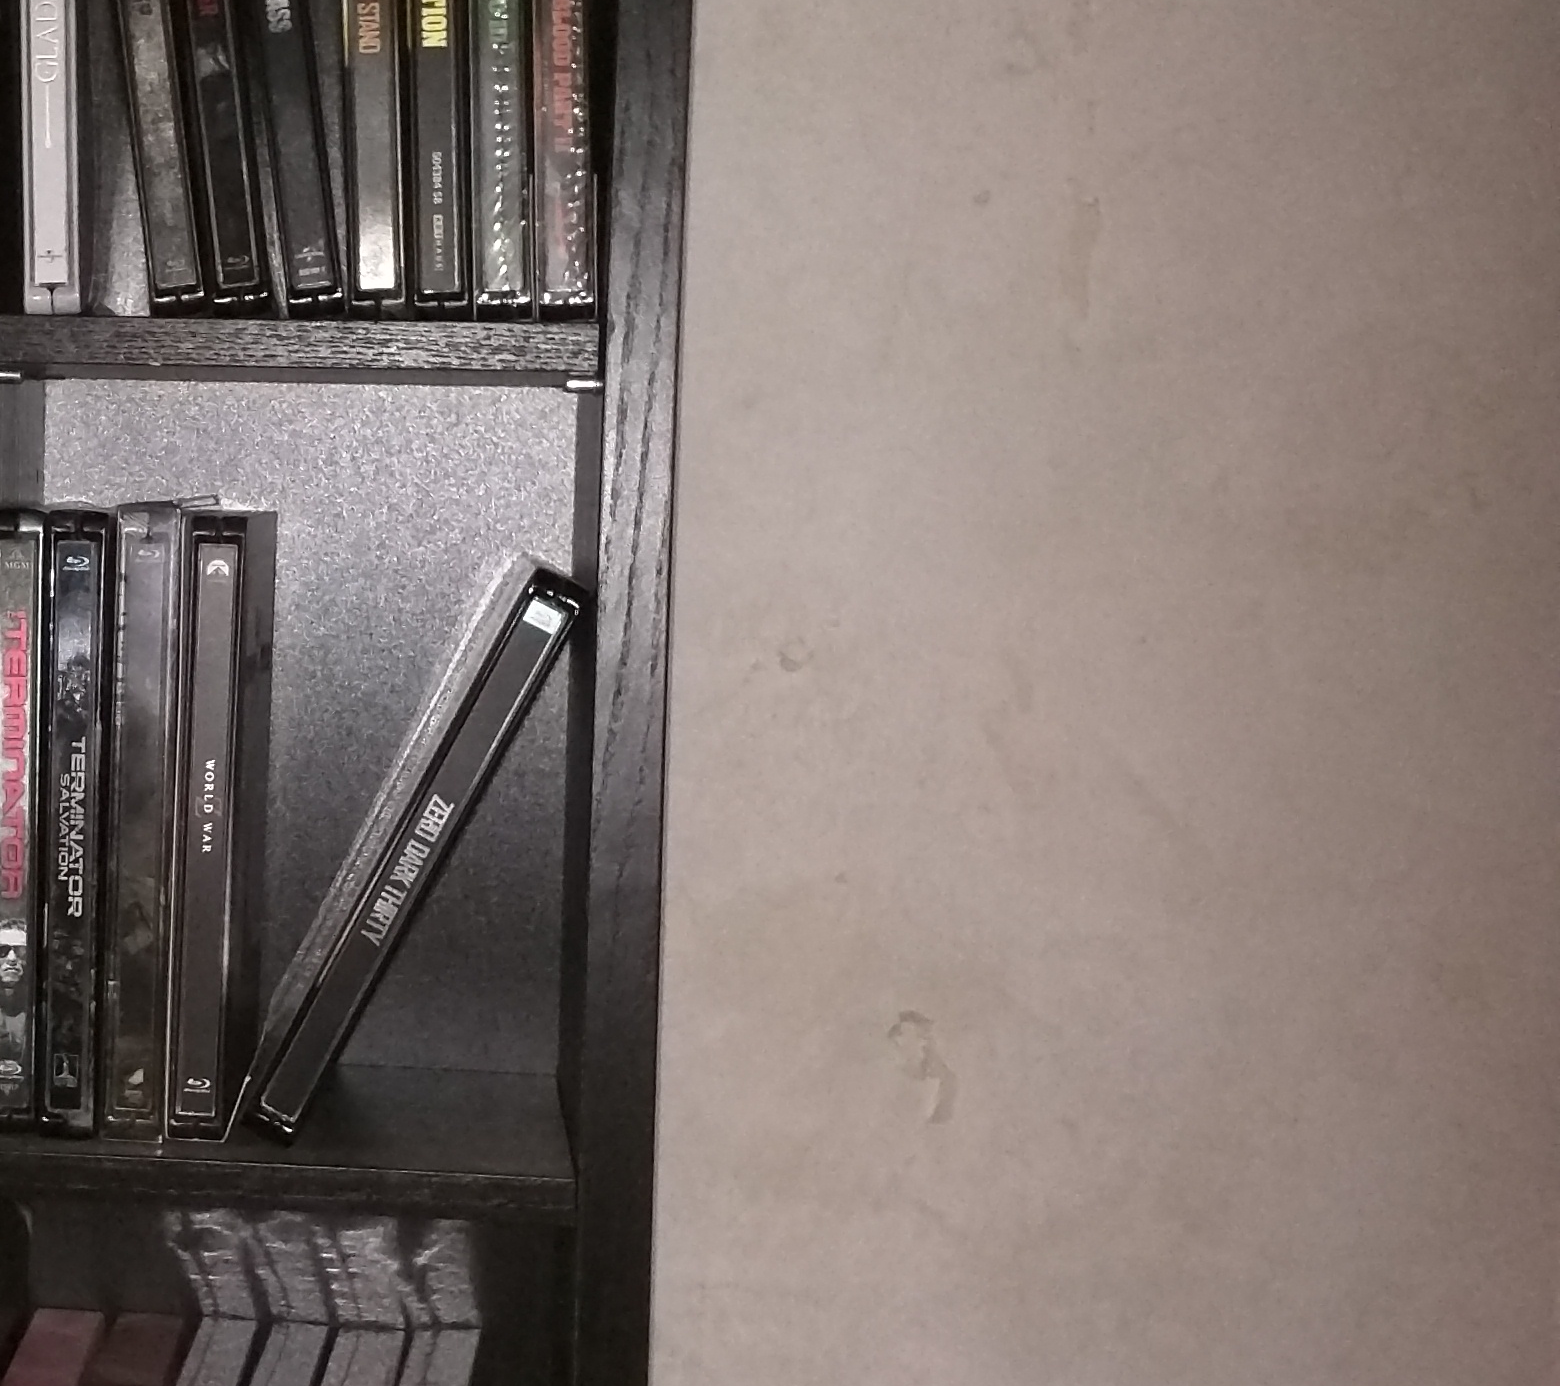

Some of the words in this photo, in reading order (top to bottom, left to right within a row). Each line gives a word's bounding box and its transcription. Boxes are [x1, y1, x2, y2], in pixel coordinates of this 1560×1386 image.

[357, 2, 382, 55] STAND
[554, 72, 573, 127] PART
[1, 612, 30, 900] TERMINATOR
[202, 758, 217, 814] WORLD
[56, 773, 71, 881] SALVATION
[67, 735, 87, 918] TERMINATOR
[201, 821, 214, 854] WAR
[414, 793, 455, 843] ZERO
[388, 839, 431, 889] DARK
[360, 881, 412, 947] THIRTY
